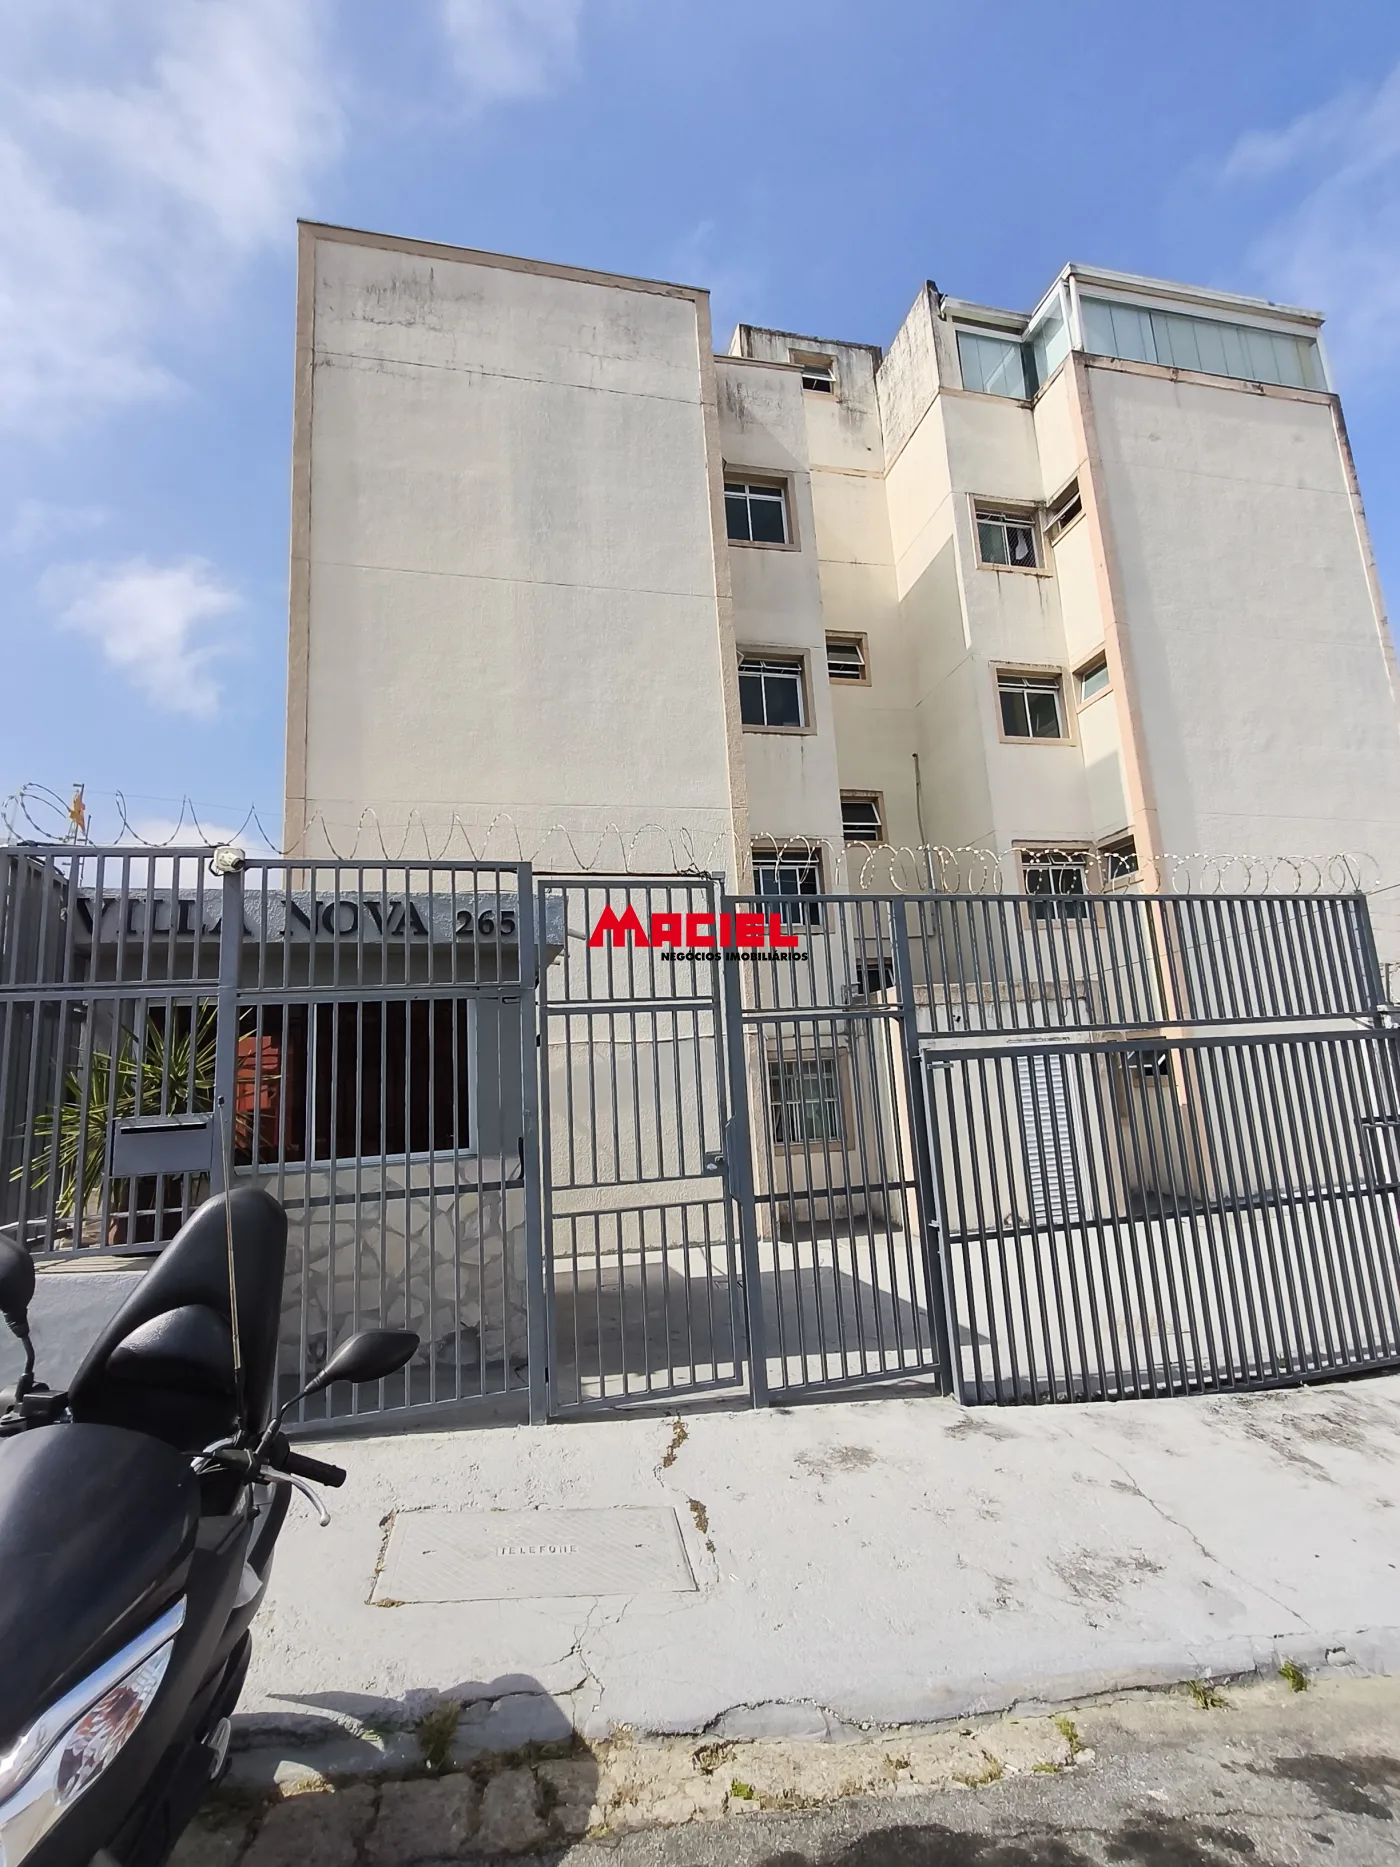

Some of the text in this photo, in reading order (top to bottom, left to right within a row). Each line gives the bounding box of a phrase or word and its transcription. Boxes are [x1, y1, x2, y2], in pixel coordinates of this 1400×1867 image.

[279, 899, 430, 937] NOVA
[455, 909, 517, 936] 265
[500, 1544, 578, 1556] TELEFONE
